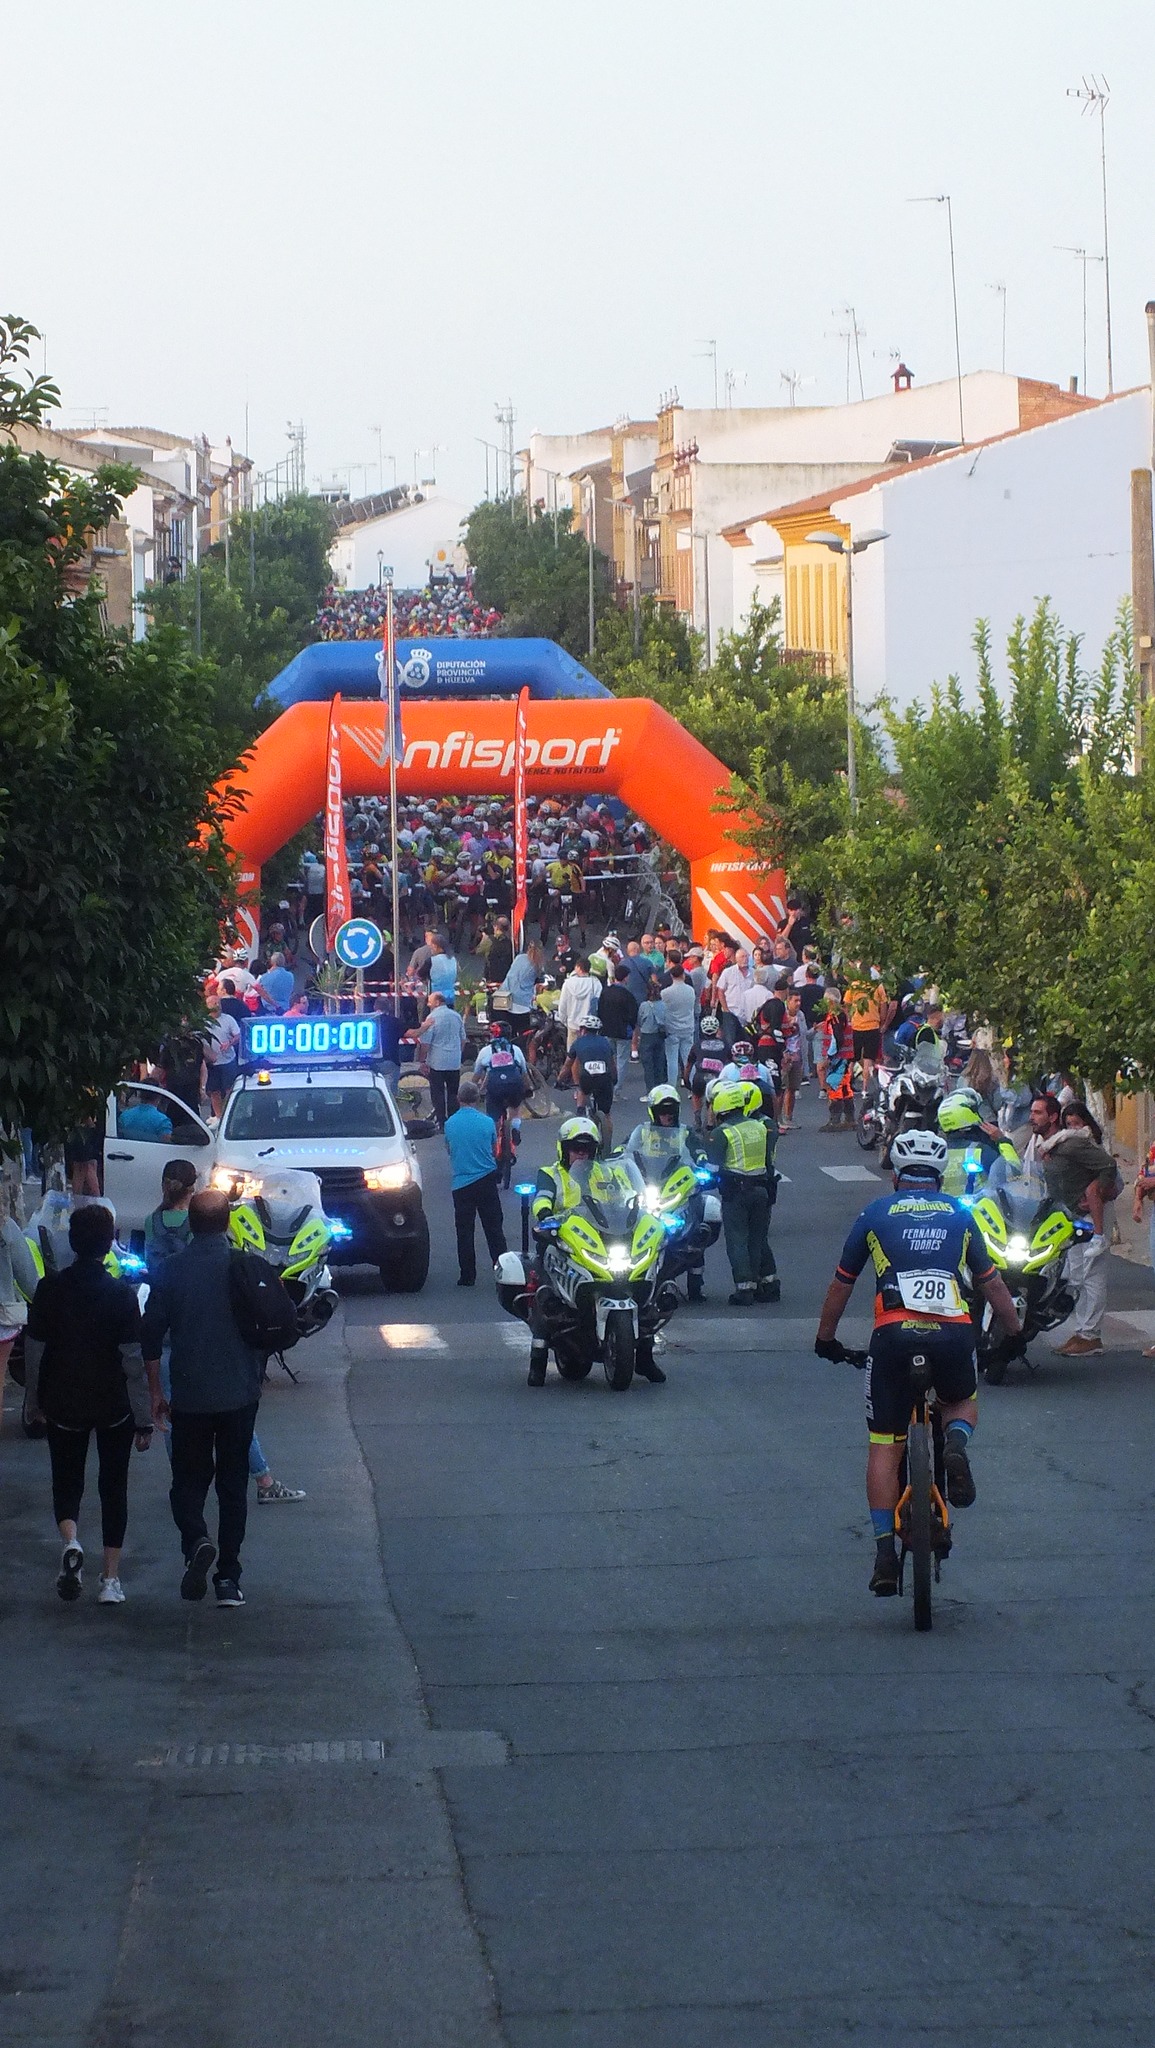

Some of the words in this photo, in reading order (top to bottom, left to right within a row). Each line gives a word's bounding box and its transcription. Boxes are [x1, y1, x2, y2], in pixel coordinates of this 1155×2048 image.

[436, 660, 486, 668] DIPUTACIÓN
[436, 668, 485, 677] PROVINCIAL
[394, 728, 620, 777] nfisport
[511, 767, 551, 776] SIENCE
[251, 1021, 374, 1053] 00:00:00
[902, 1228, 948, 1240] FERNANDO
[910, 1239, 942, 1251] TORRES
[912, 1280, 946, 1300] 298
